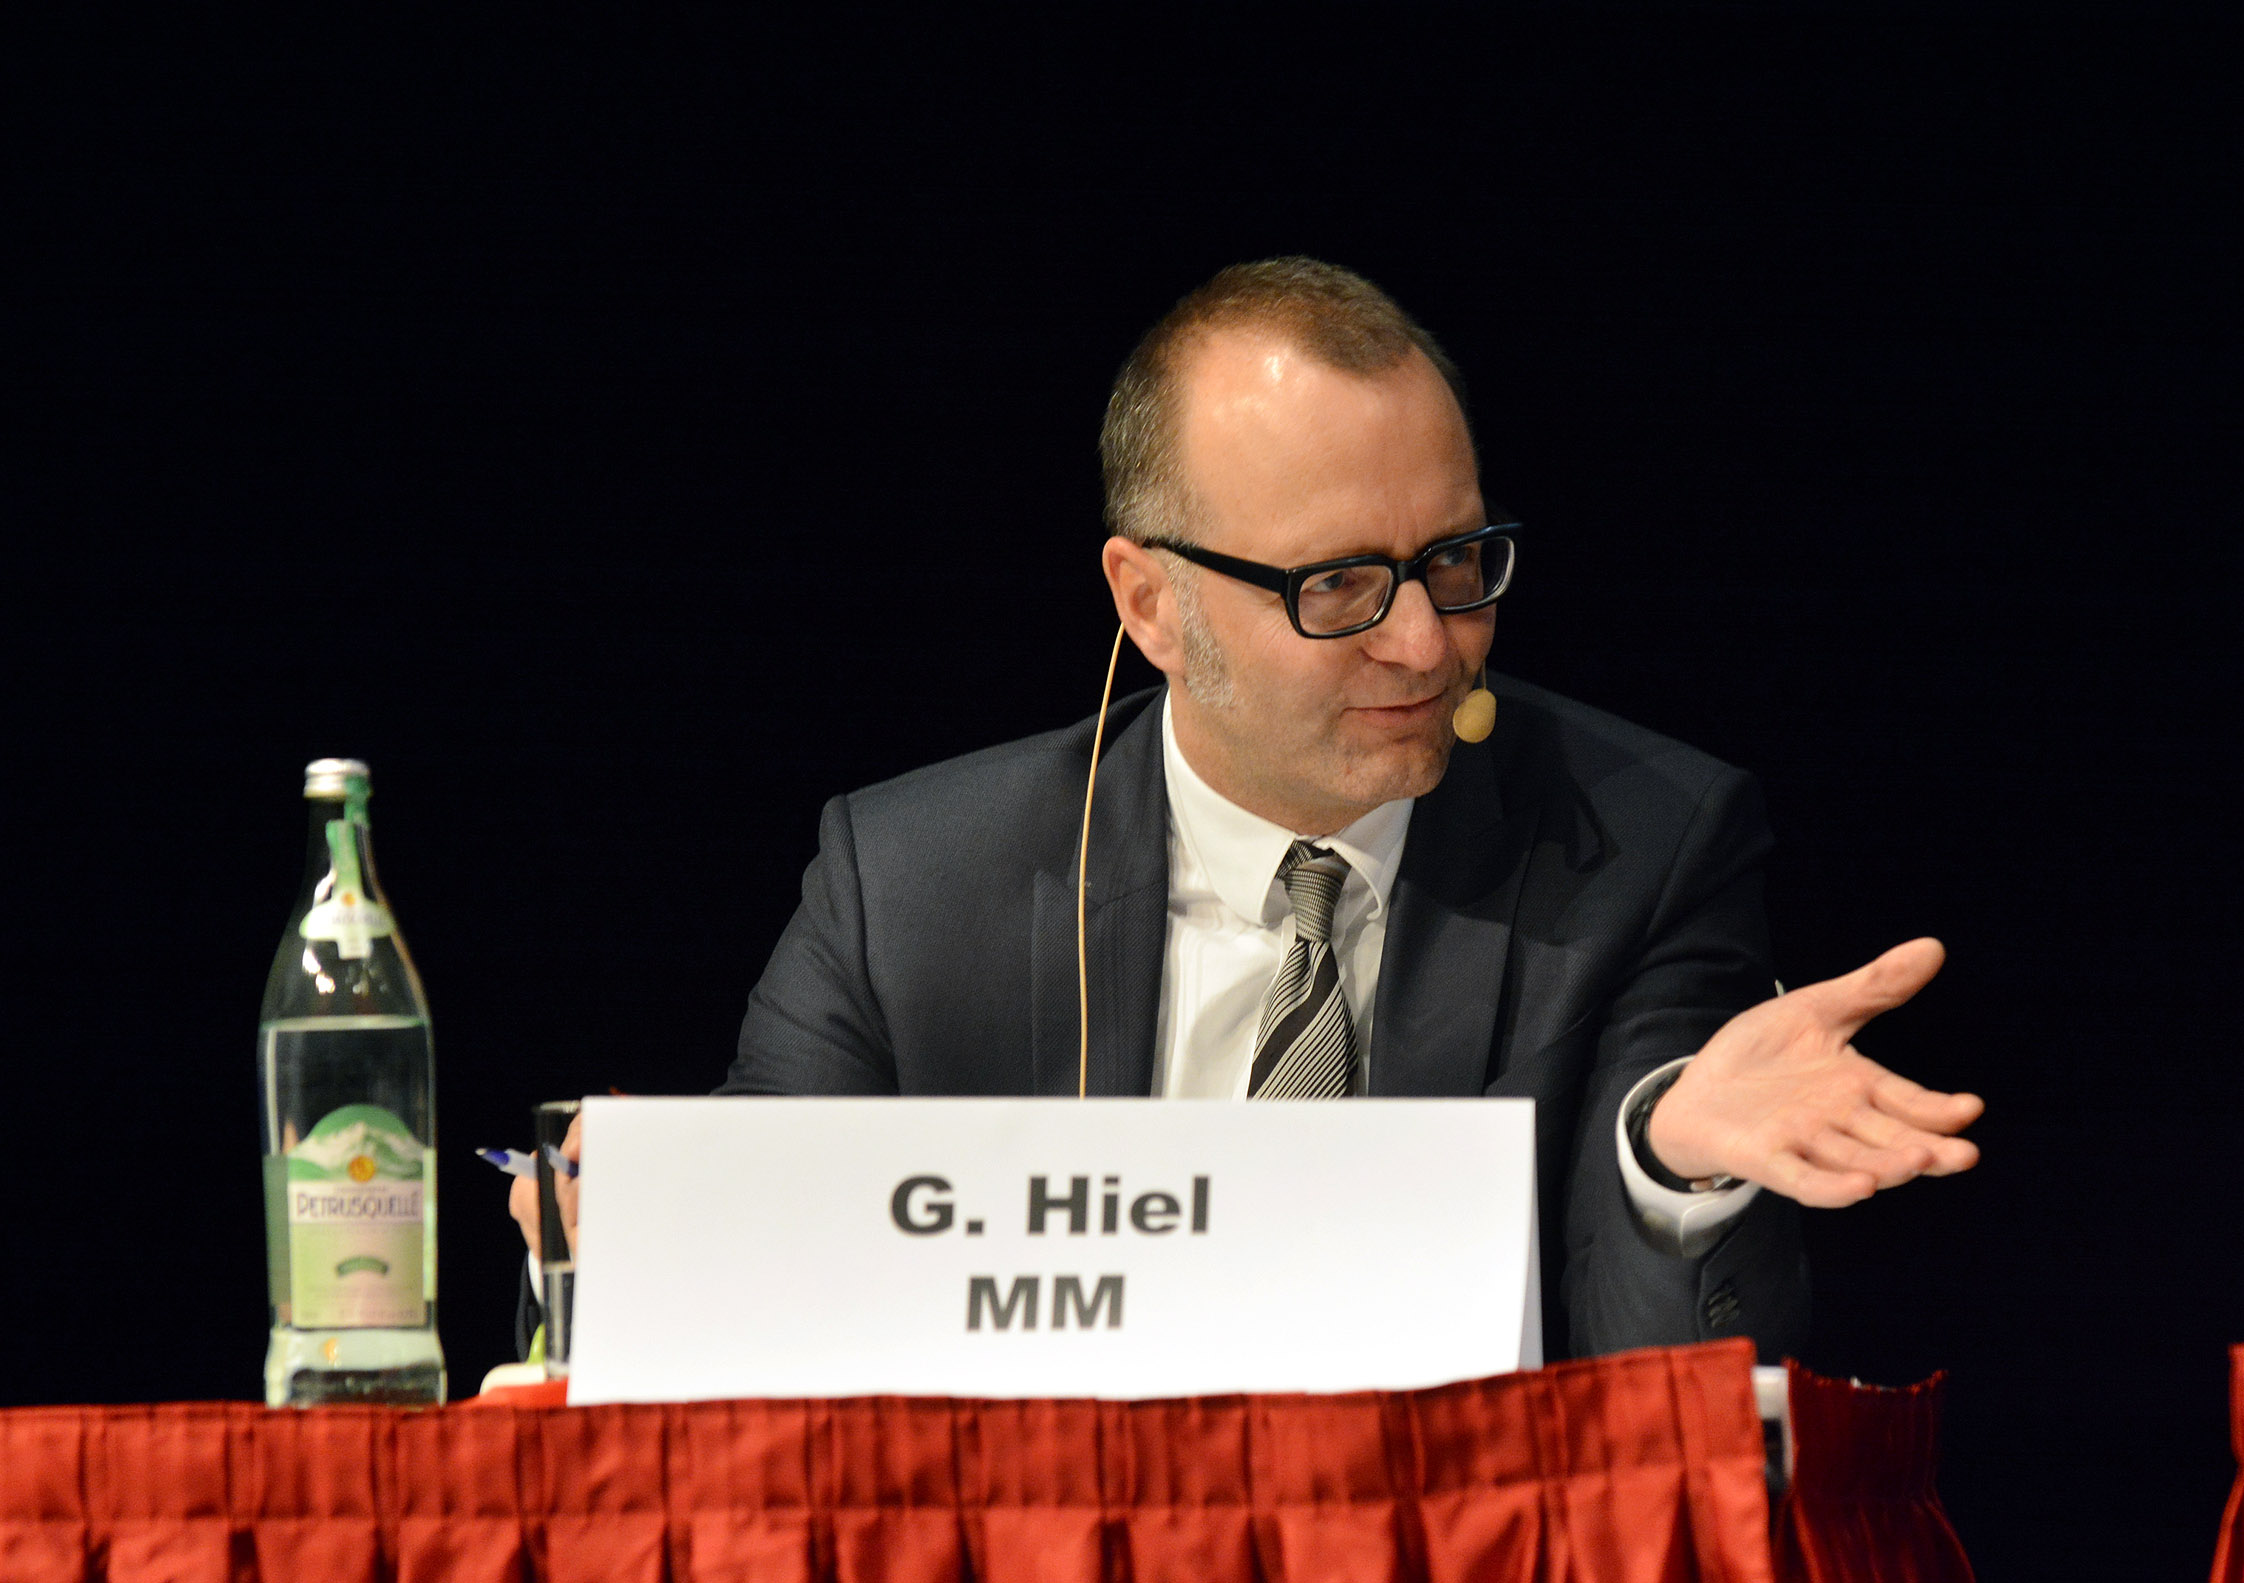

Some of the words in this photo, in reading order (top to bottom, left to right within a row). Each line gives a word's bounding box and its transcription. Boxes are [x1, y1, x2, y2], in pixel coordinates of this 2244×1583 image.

[890, 1174, 984, 1236] G.
[1027, 1175, 1211, 1235] Hiel
[967, 1275, 1125, 1331] MM
